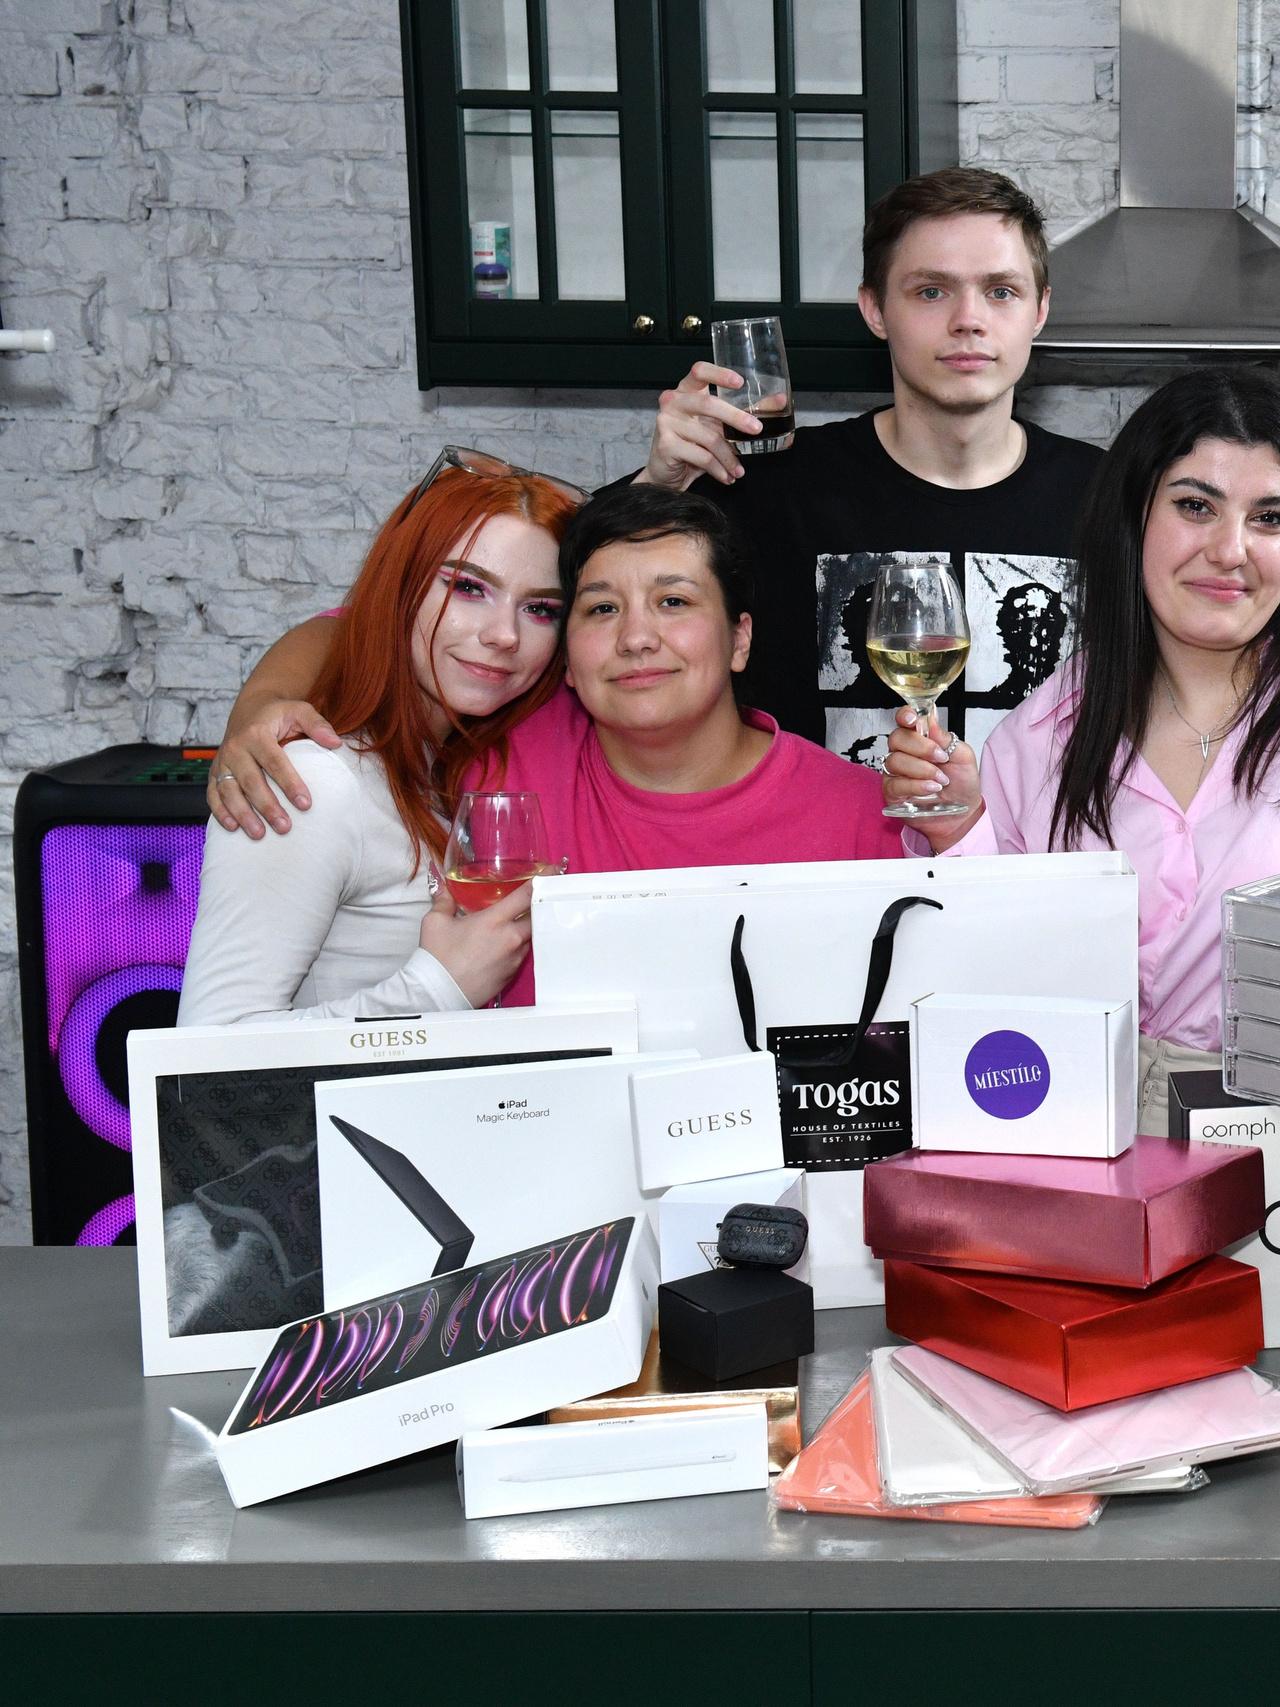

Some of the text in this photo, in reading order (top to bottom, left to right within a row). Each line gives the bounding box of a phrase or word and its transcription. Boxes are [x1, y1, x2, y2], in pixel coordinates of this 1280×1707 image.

[350, 1029, 427, 1049] GUESS
[373, 1050, 385, 1058] EST
[506, 1099, 528, 1109] iPad
[476, 1108, 550, 1124] Magic Keyboard
[667, 1108, 752, 1138] GUESS
[792, 1120, 900, 1132] HOUSE OF TEXTILES
[1202, 1117, 1276, 1140] oomph
[848, 1134, 871, 1142] 1926
[745, 1225, 775, 1235] GUESS
[398, 1402, 454, 1427] iPad Pro
